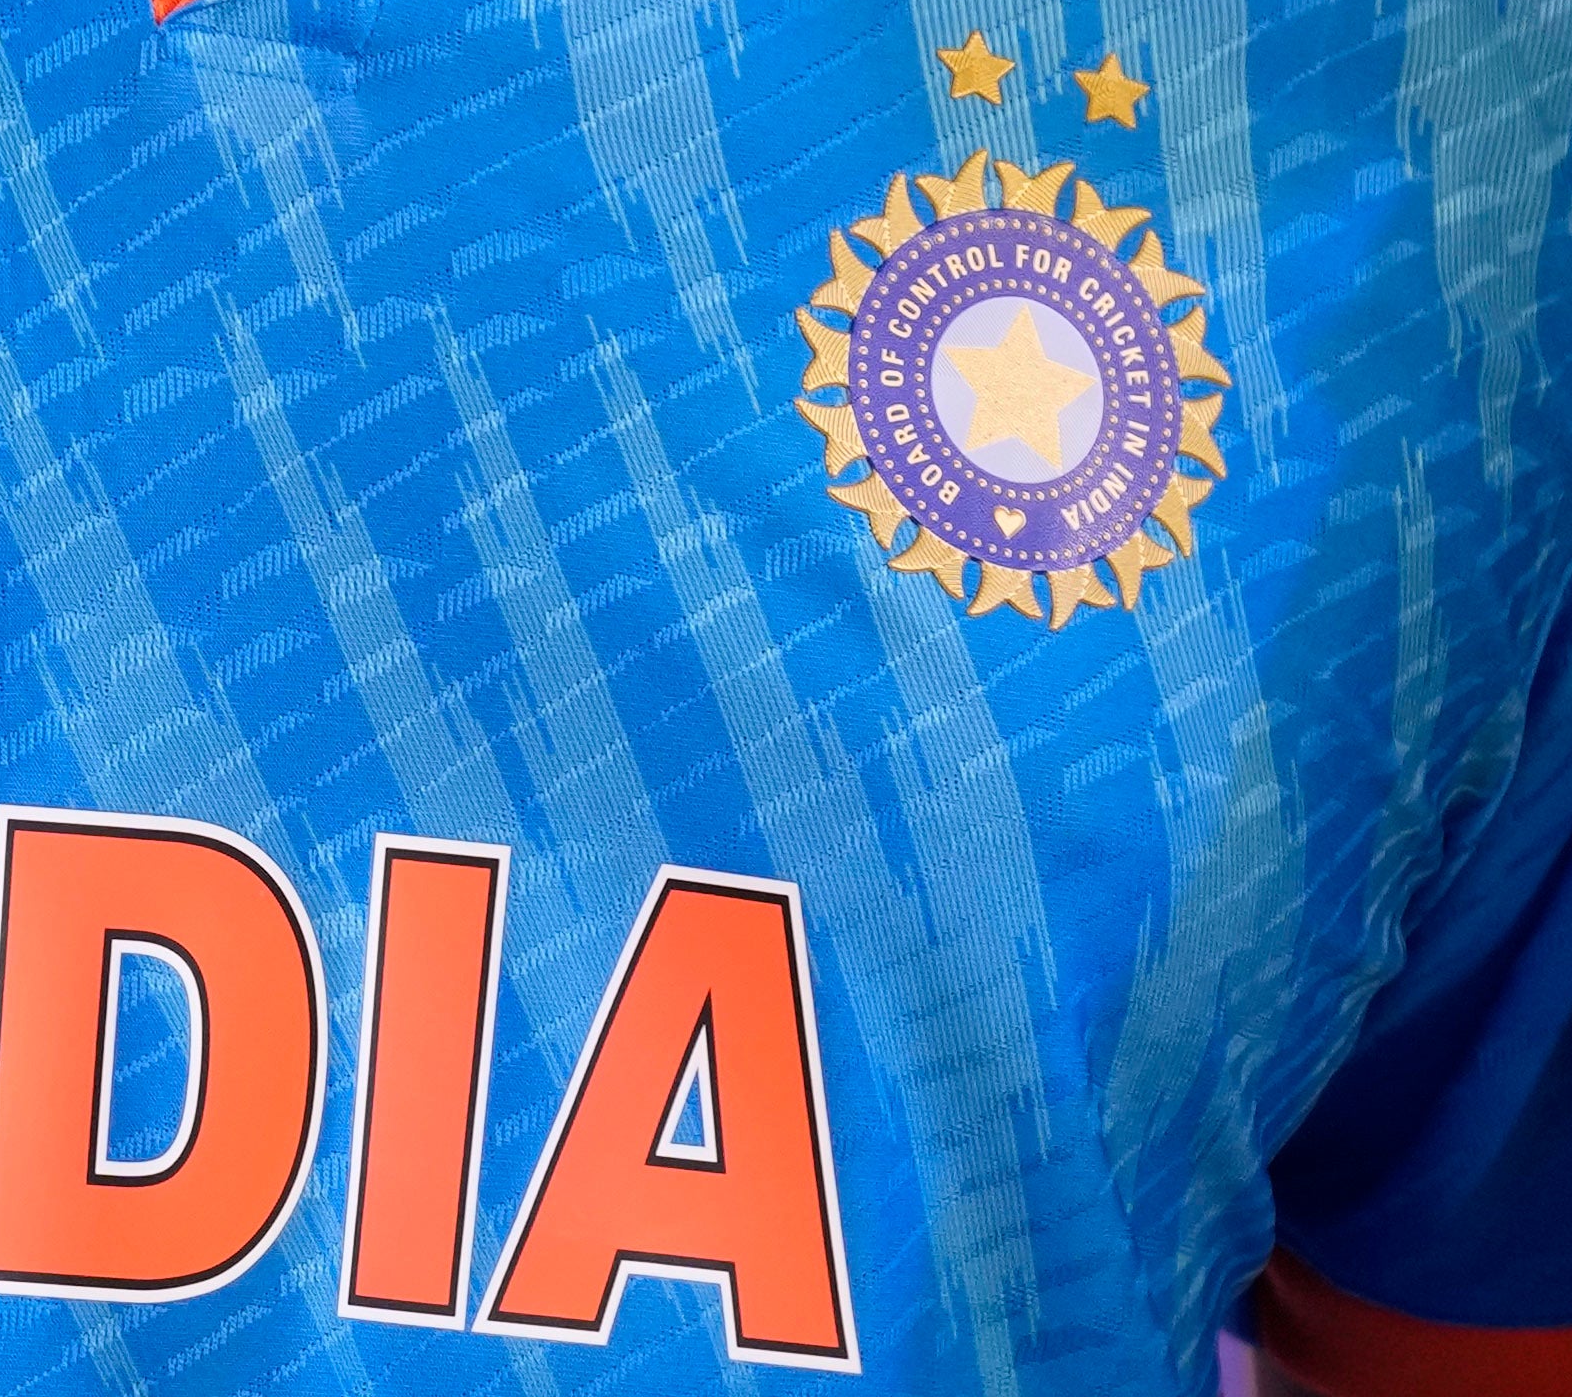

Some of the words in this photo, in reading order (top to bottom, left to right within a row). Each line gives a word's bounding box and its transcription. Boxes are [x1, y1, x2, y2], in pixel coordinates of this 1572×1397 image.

[888, 243, 1005, 339] CONTROL
[1014, 243, 1073, 285] FOR
[879, 349, 906, 388] OF
[1079, 276, 1151, 409] CRICKET
[885, 402, 961, 507] BOARD
[1121, 422, 1148, 460] IN
[1060, 461, 1136, 533] INDIA
